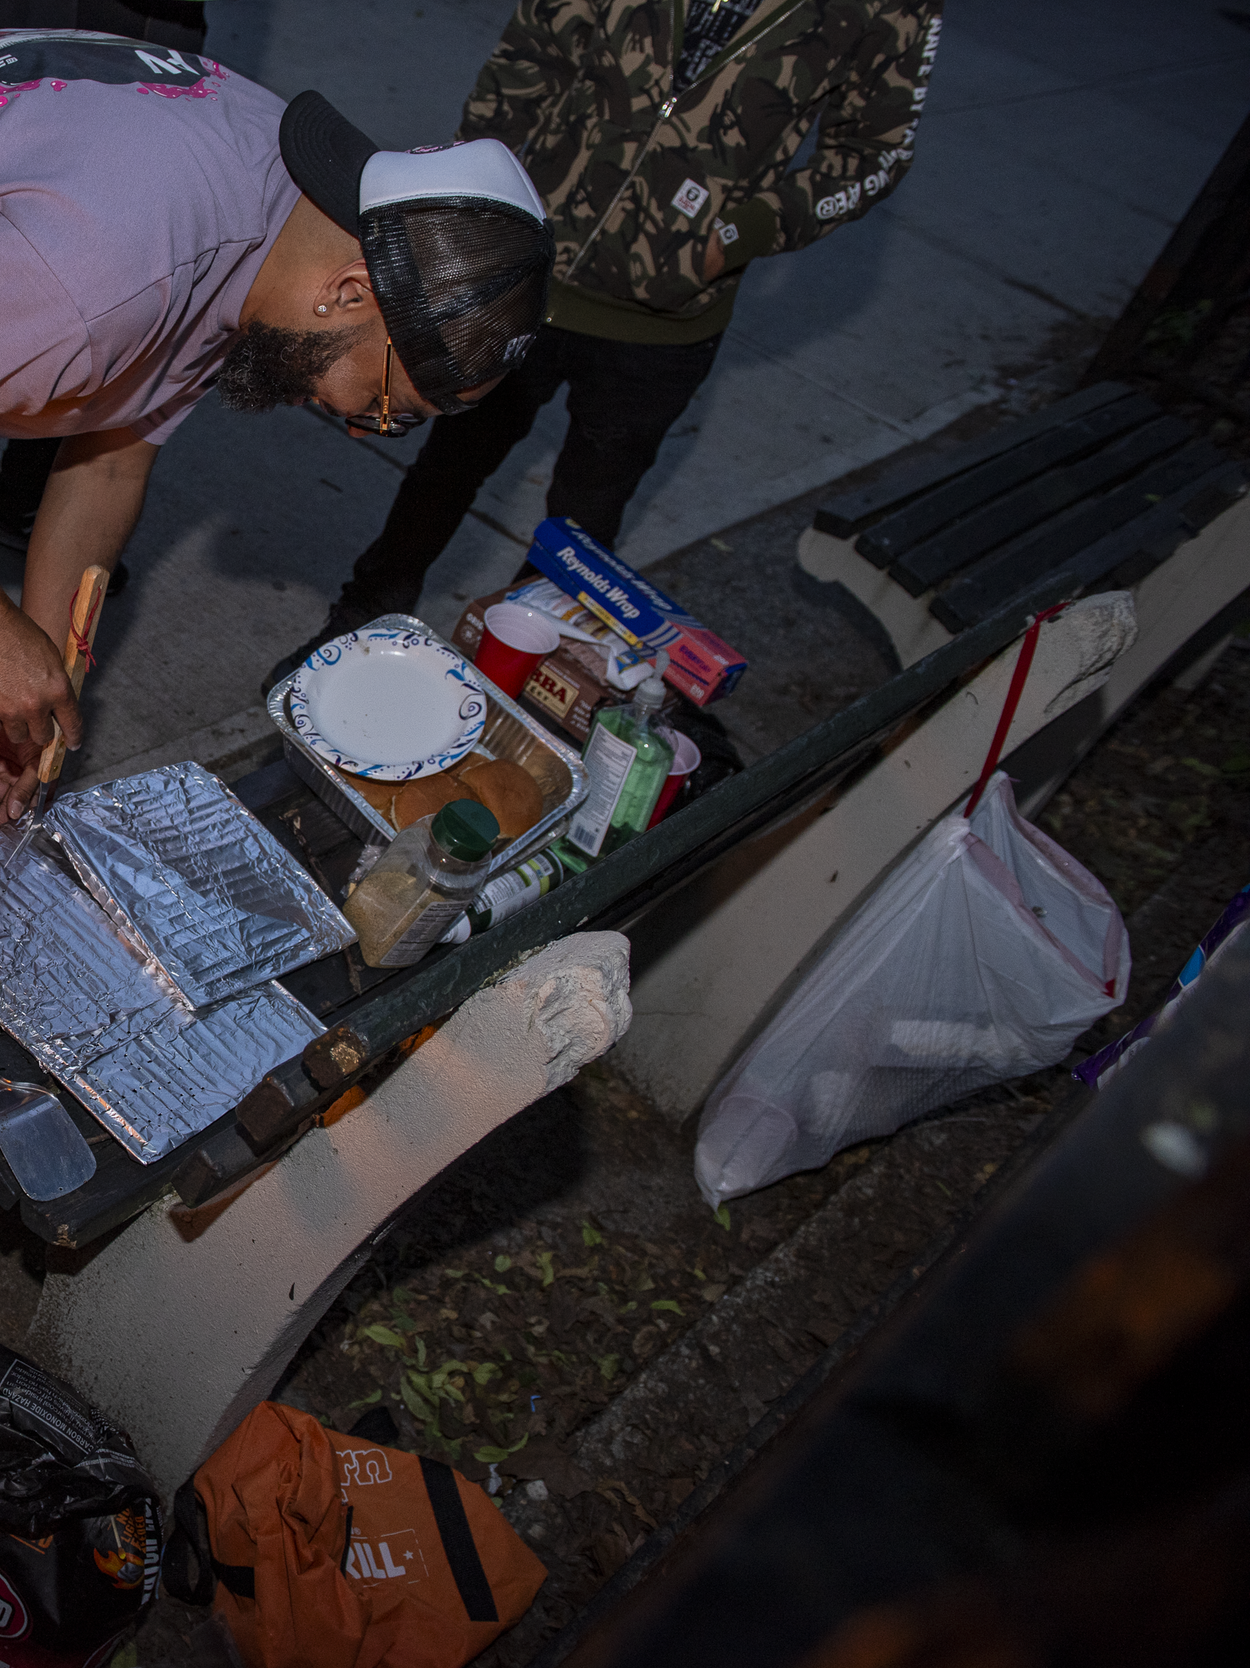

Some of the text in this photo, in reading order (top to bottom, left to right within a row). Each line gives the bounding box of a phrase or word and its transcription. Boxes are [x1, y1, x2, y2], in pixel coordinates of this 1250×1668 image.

[910, 87, 928, 112] BY
[555, 545, 611, 593] Reynolds
[605, 586, 640, 619] Wrap
[2, 1388, 31, 1407] HAZARD
[30, 1402, 67, 1430] MONOXIDE
[66, 1428, 94, 1451] CARBON
